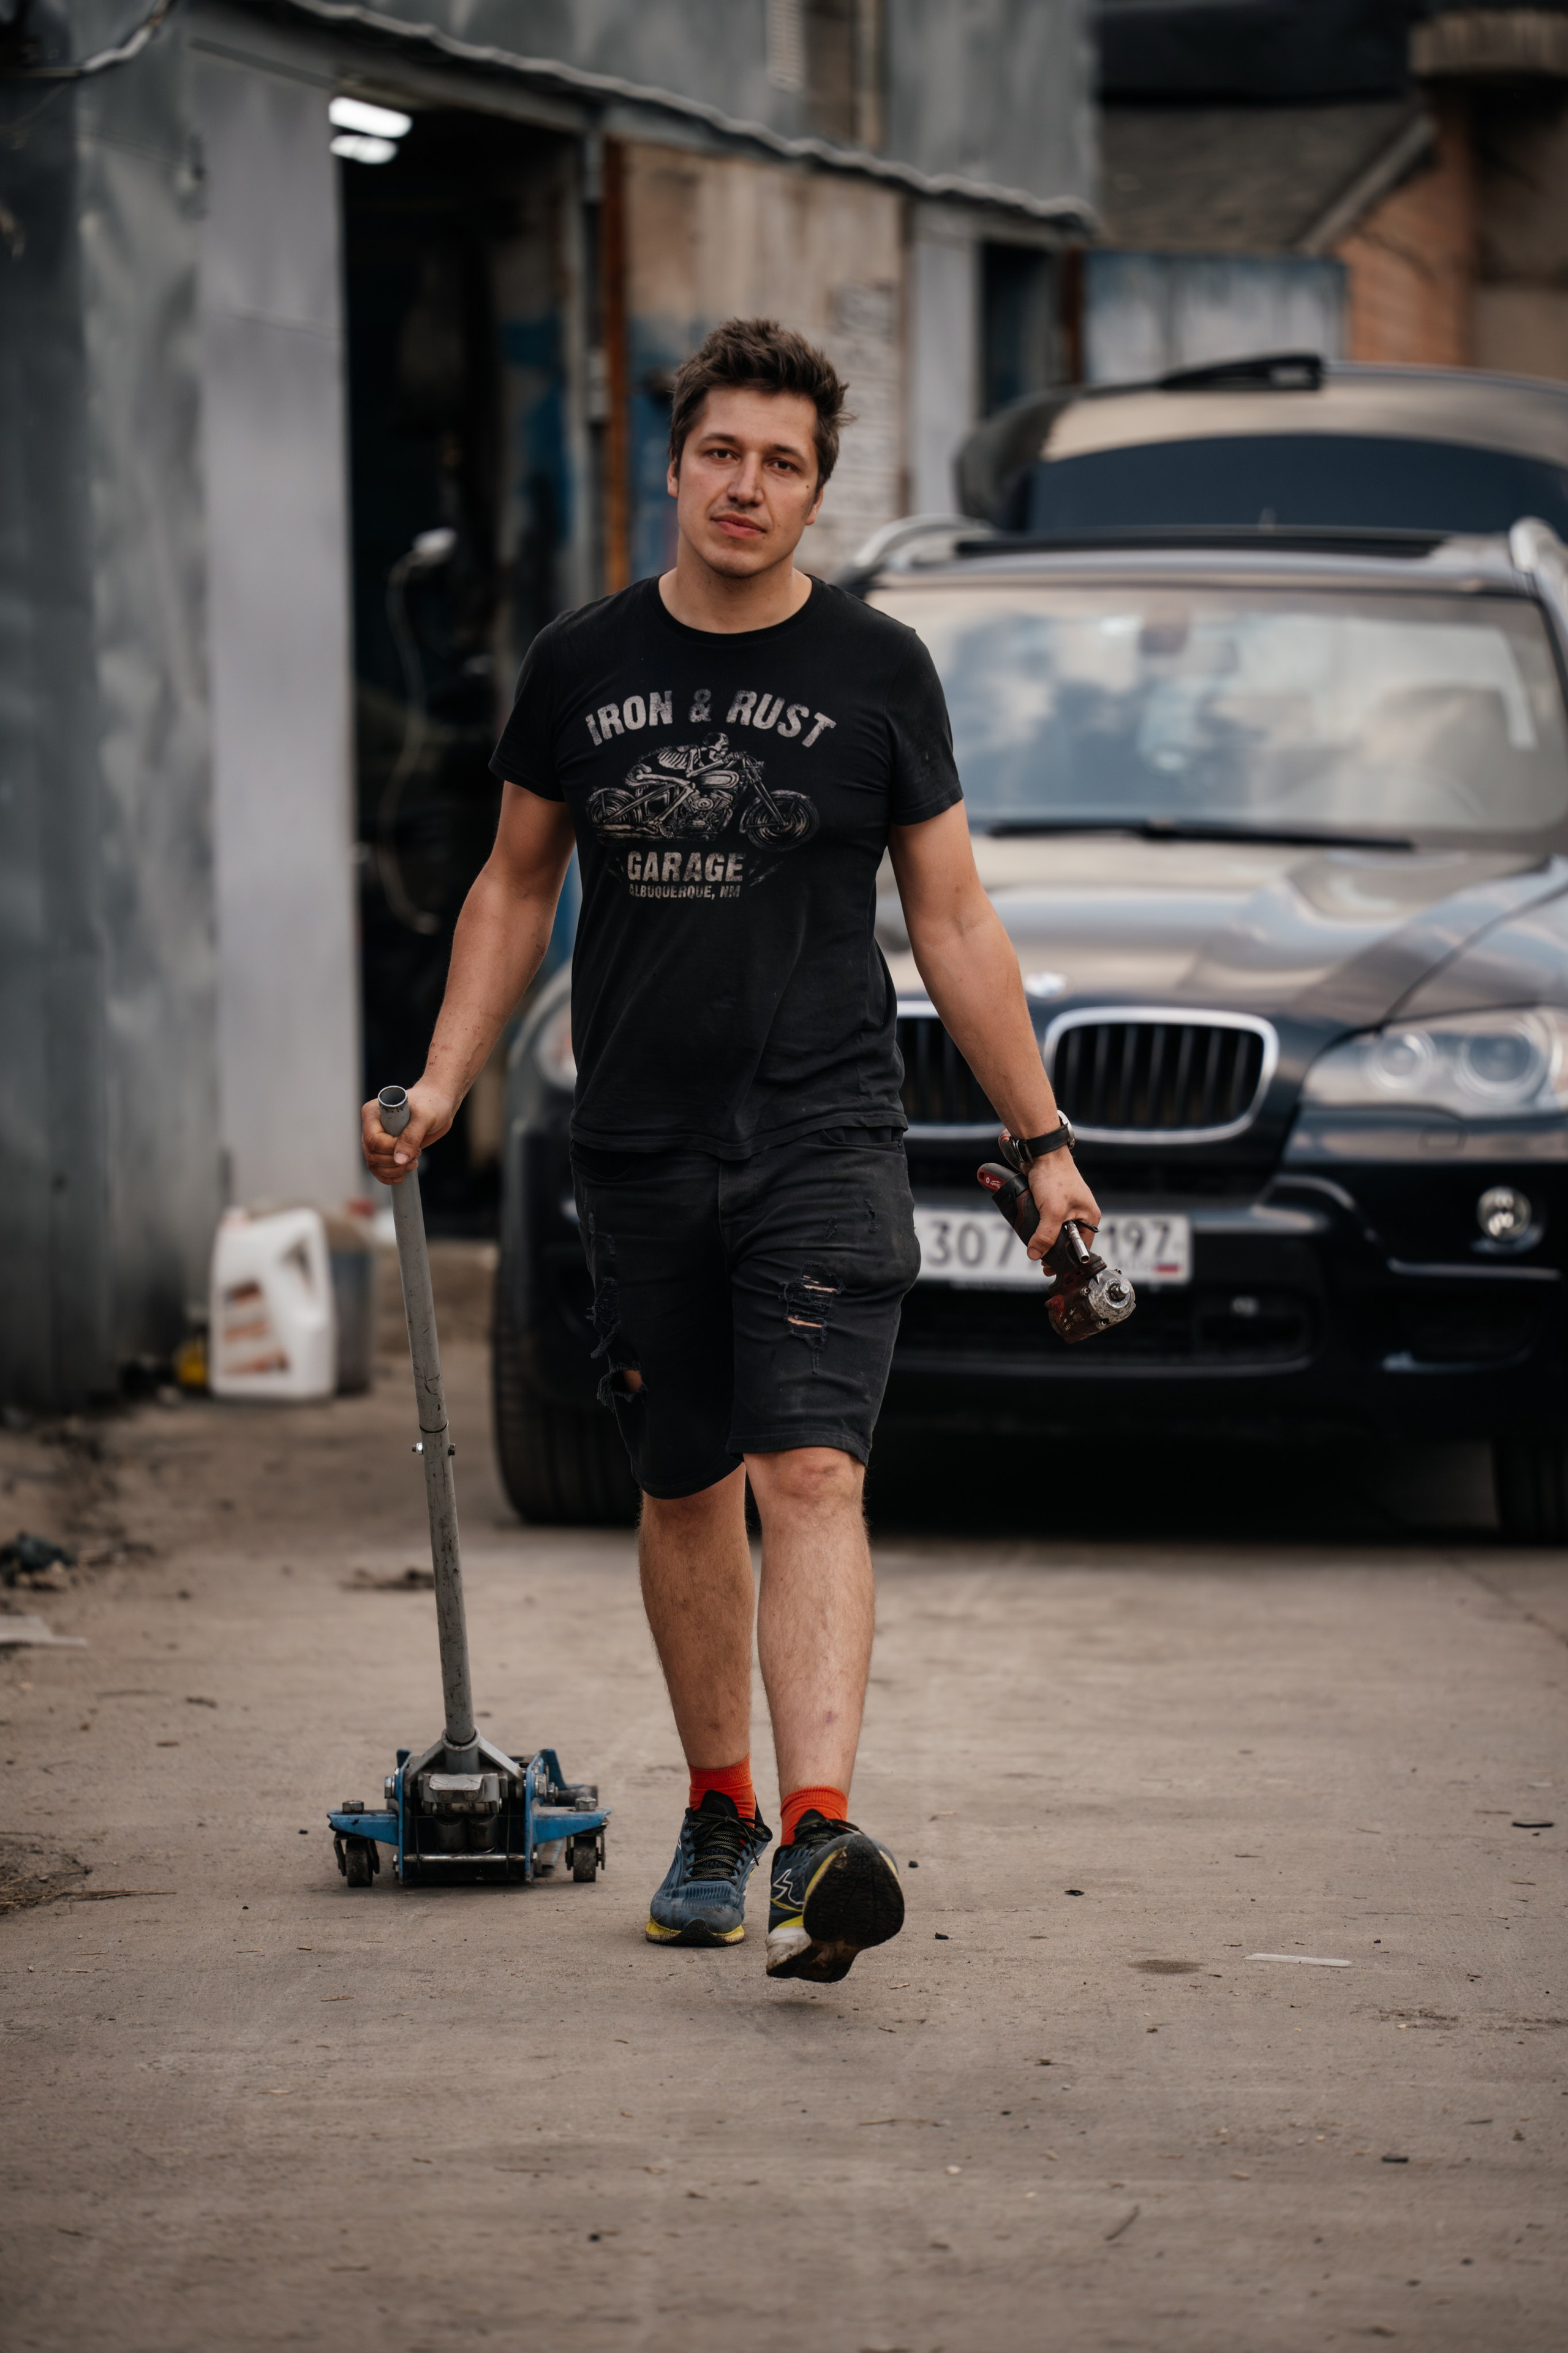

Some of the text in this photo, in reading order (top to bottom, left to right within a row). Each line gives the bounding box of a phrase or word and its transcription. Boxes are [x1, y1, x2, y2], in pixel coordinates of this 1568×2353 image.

[585, 688, 837, 748] IRON & RUST
[627, 850, 745, 882] GARAGE
[629, 884, 741, 900] ALBUQUERQUE, NM
[1104, 1220, 1170, 1260] 197
